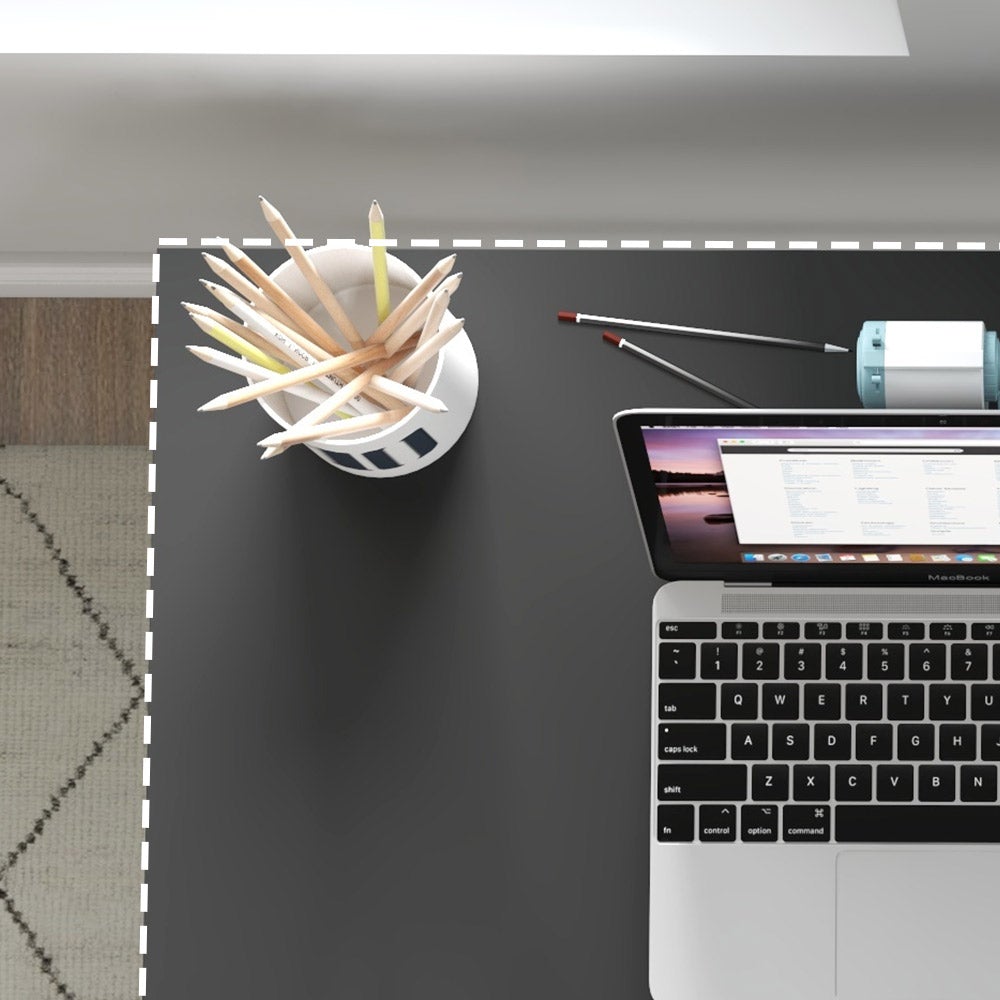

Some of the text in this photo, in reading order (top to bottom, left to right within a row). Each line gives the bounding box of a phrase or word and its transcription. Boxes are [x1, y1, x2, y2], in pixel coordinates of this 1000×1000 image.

[715, 660, 720, 671] 1
[756, 660, 764, 671] 2
[797, 660, 806, 671] 3
[839, 660, 847, 671] 4
[881, 660, 889, 672] 5
[922, 660, 931, 672] 6
[965, 660, 972, 672] 7
[733, 694, 743, 706] Q
[774, 694, 786, 705] W
[818, 694, 825, 706] E
[859, 694, 868, 705] R
[901, 694, 910, 705] T
[943, 695, 952, 705] Y
[984, 695, 994, 706] U
[664, 704, 677, 712] tab
[744, 735, 753, 746] A
[786, 734, 795, 746] S
[827, 735, 837, 746] D
[870, 735, 877, 746] F
[911, 735, 920, 747] G
[953, 735, 962, 746] H
[664, 745, 698, 754] caps lock
[765, 775, 773, 787] Z
[806, 776, 815, 786] X
[848, 775, 857, 787] C
[890, 776, 899, 787] V
[932, 776, 941, 787] B
[973, 776, 983, 787] N
[663, 785, 681, 794] shift
[663, 826, 672, 834] fn
[703, 826, 730, 835] control
[747, 827, 772, 836] option
[787, 827, 825, 835] command
